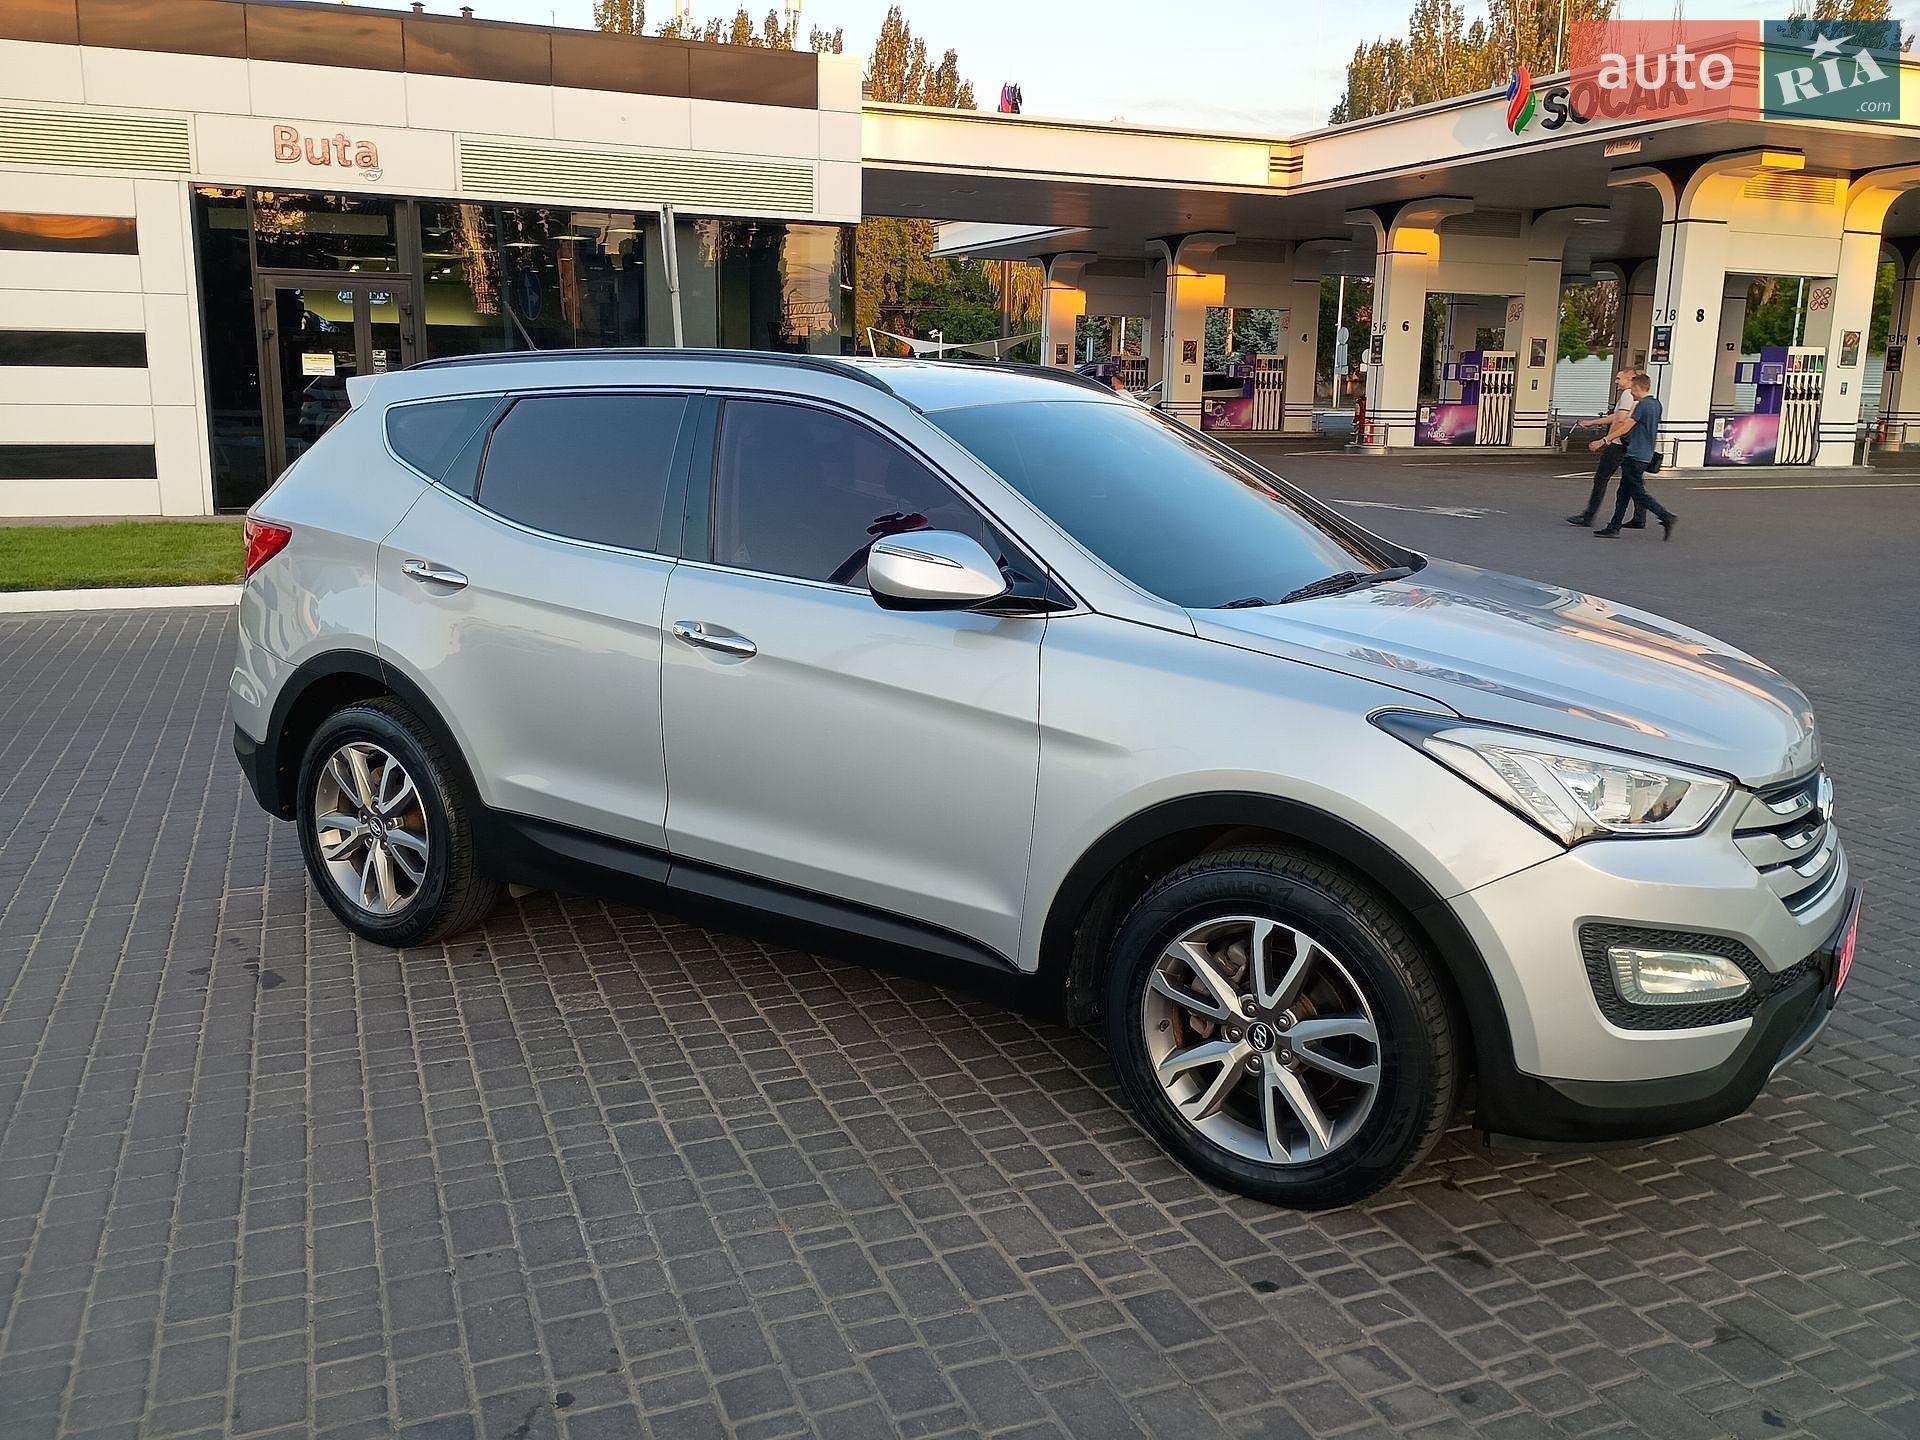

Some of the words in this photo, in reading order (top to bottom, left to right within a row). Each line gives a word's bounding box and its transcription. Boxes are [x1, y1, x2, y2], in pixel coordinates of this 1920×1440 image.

[1540, 60, 1689, 131] SOCAR
[273, 124, 379, 168] Buta
[1655, 309, 1663, 321] 7
[1669, 309, 1677, 321] 8
[1696, 308, 1705, 323] 8
[1373, 322, 1378, 332] 5
[1381, 321, 1387, 332] 6
[1402, 320, 1410, 332] 6
[1301, 333, 1308, 343] 4
[1725, 342, 1735, 351] 12
